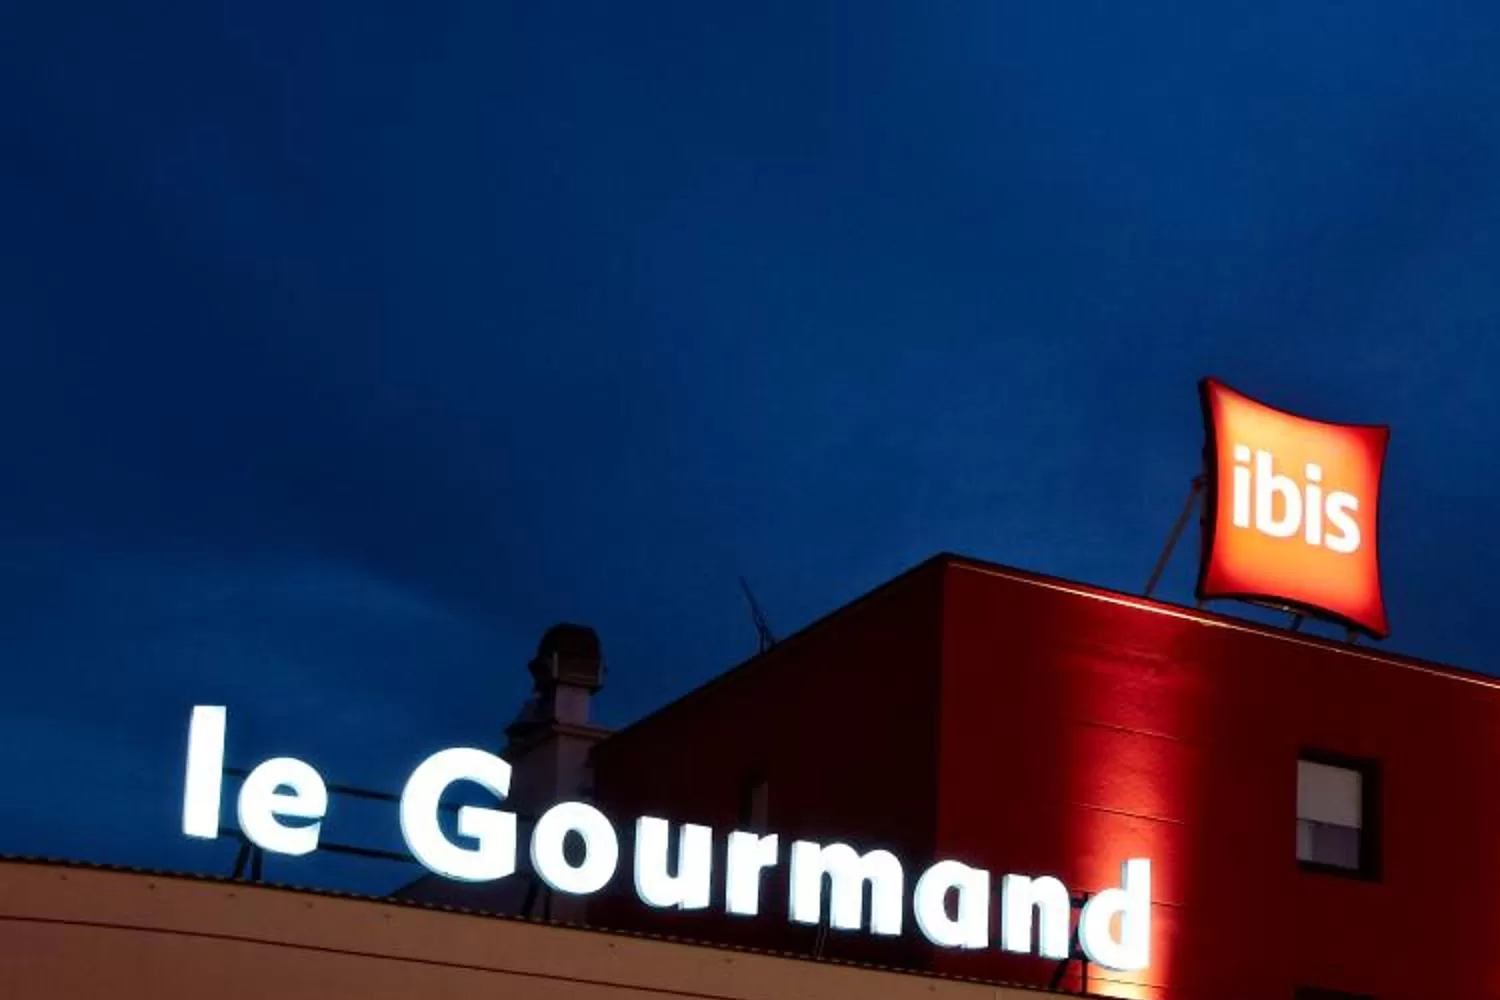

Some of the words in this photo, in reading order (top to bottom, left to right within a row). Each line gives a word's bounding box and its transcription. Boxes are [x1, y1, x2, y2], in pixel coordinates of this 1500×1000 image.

[1233, 443, 1361, 553] ibis
[182, 705, 329, 856] le
[399, 746, 1152, 971] Gourmand
